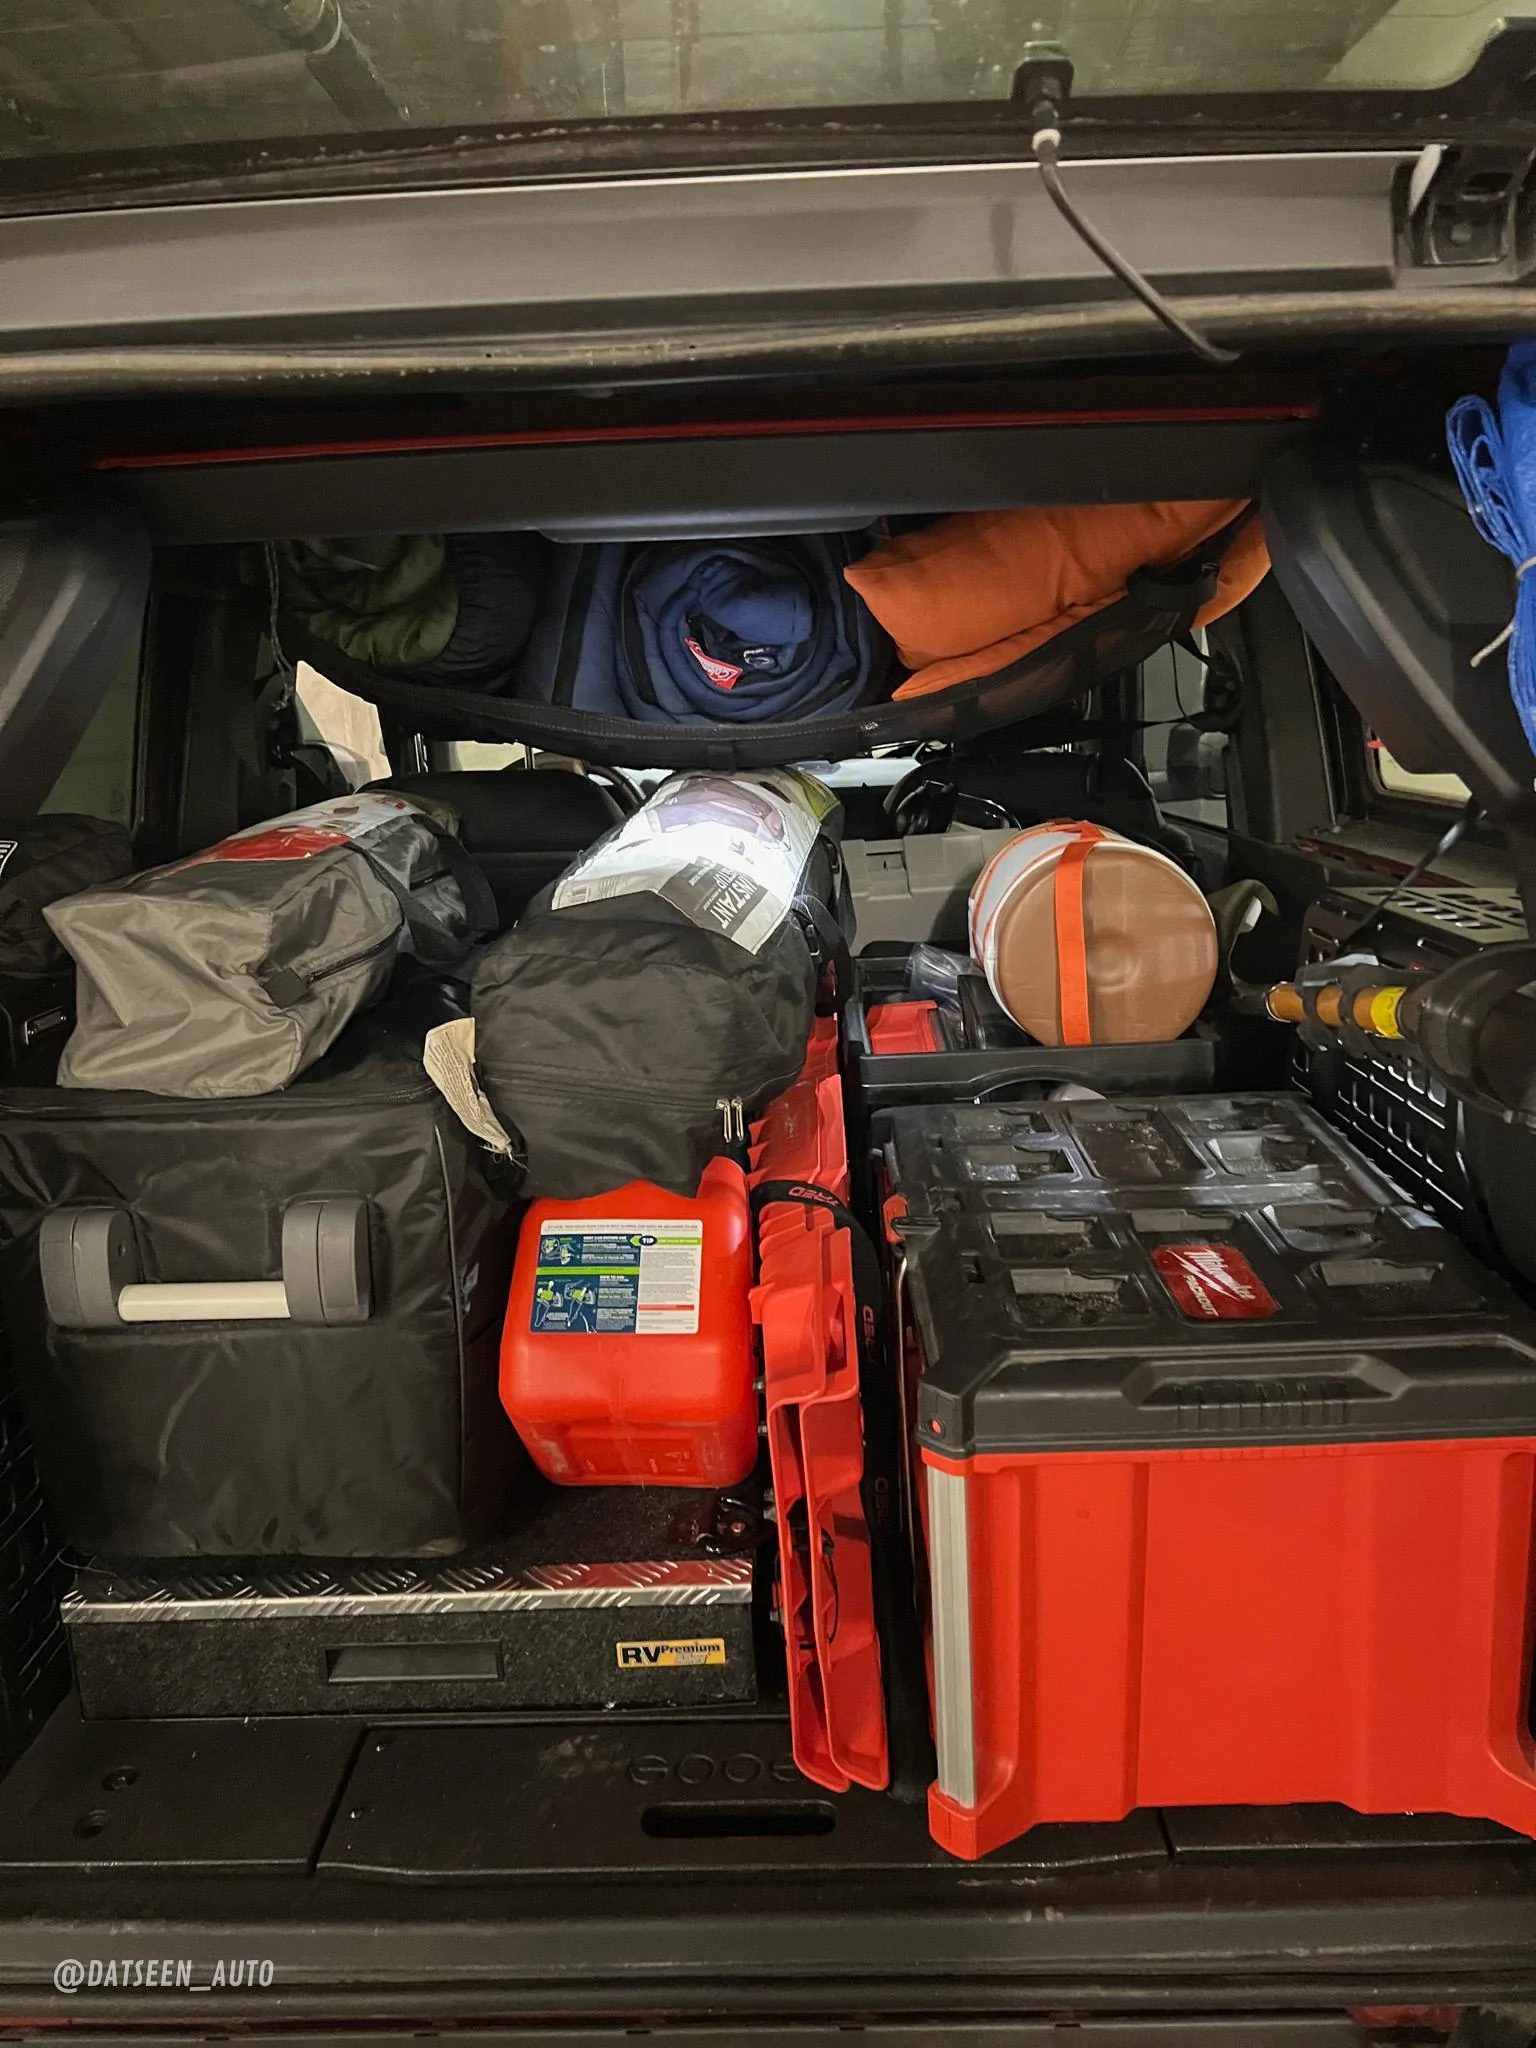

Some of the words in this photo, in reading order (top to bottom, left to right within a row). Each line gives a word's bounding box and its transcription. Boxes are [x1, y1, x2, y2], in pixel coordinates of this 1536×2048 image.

[709, 870, 758, 930] INSTANT
[621, 1646, 661, 1664] RV
[661, 1642, 720, 1654] Premium
